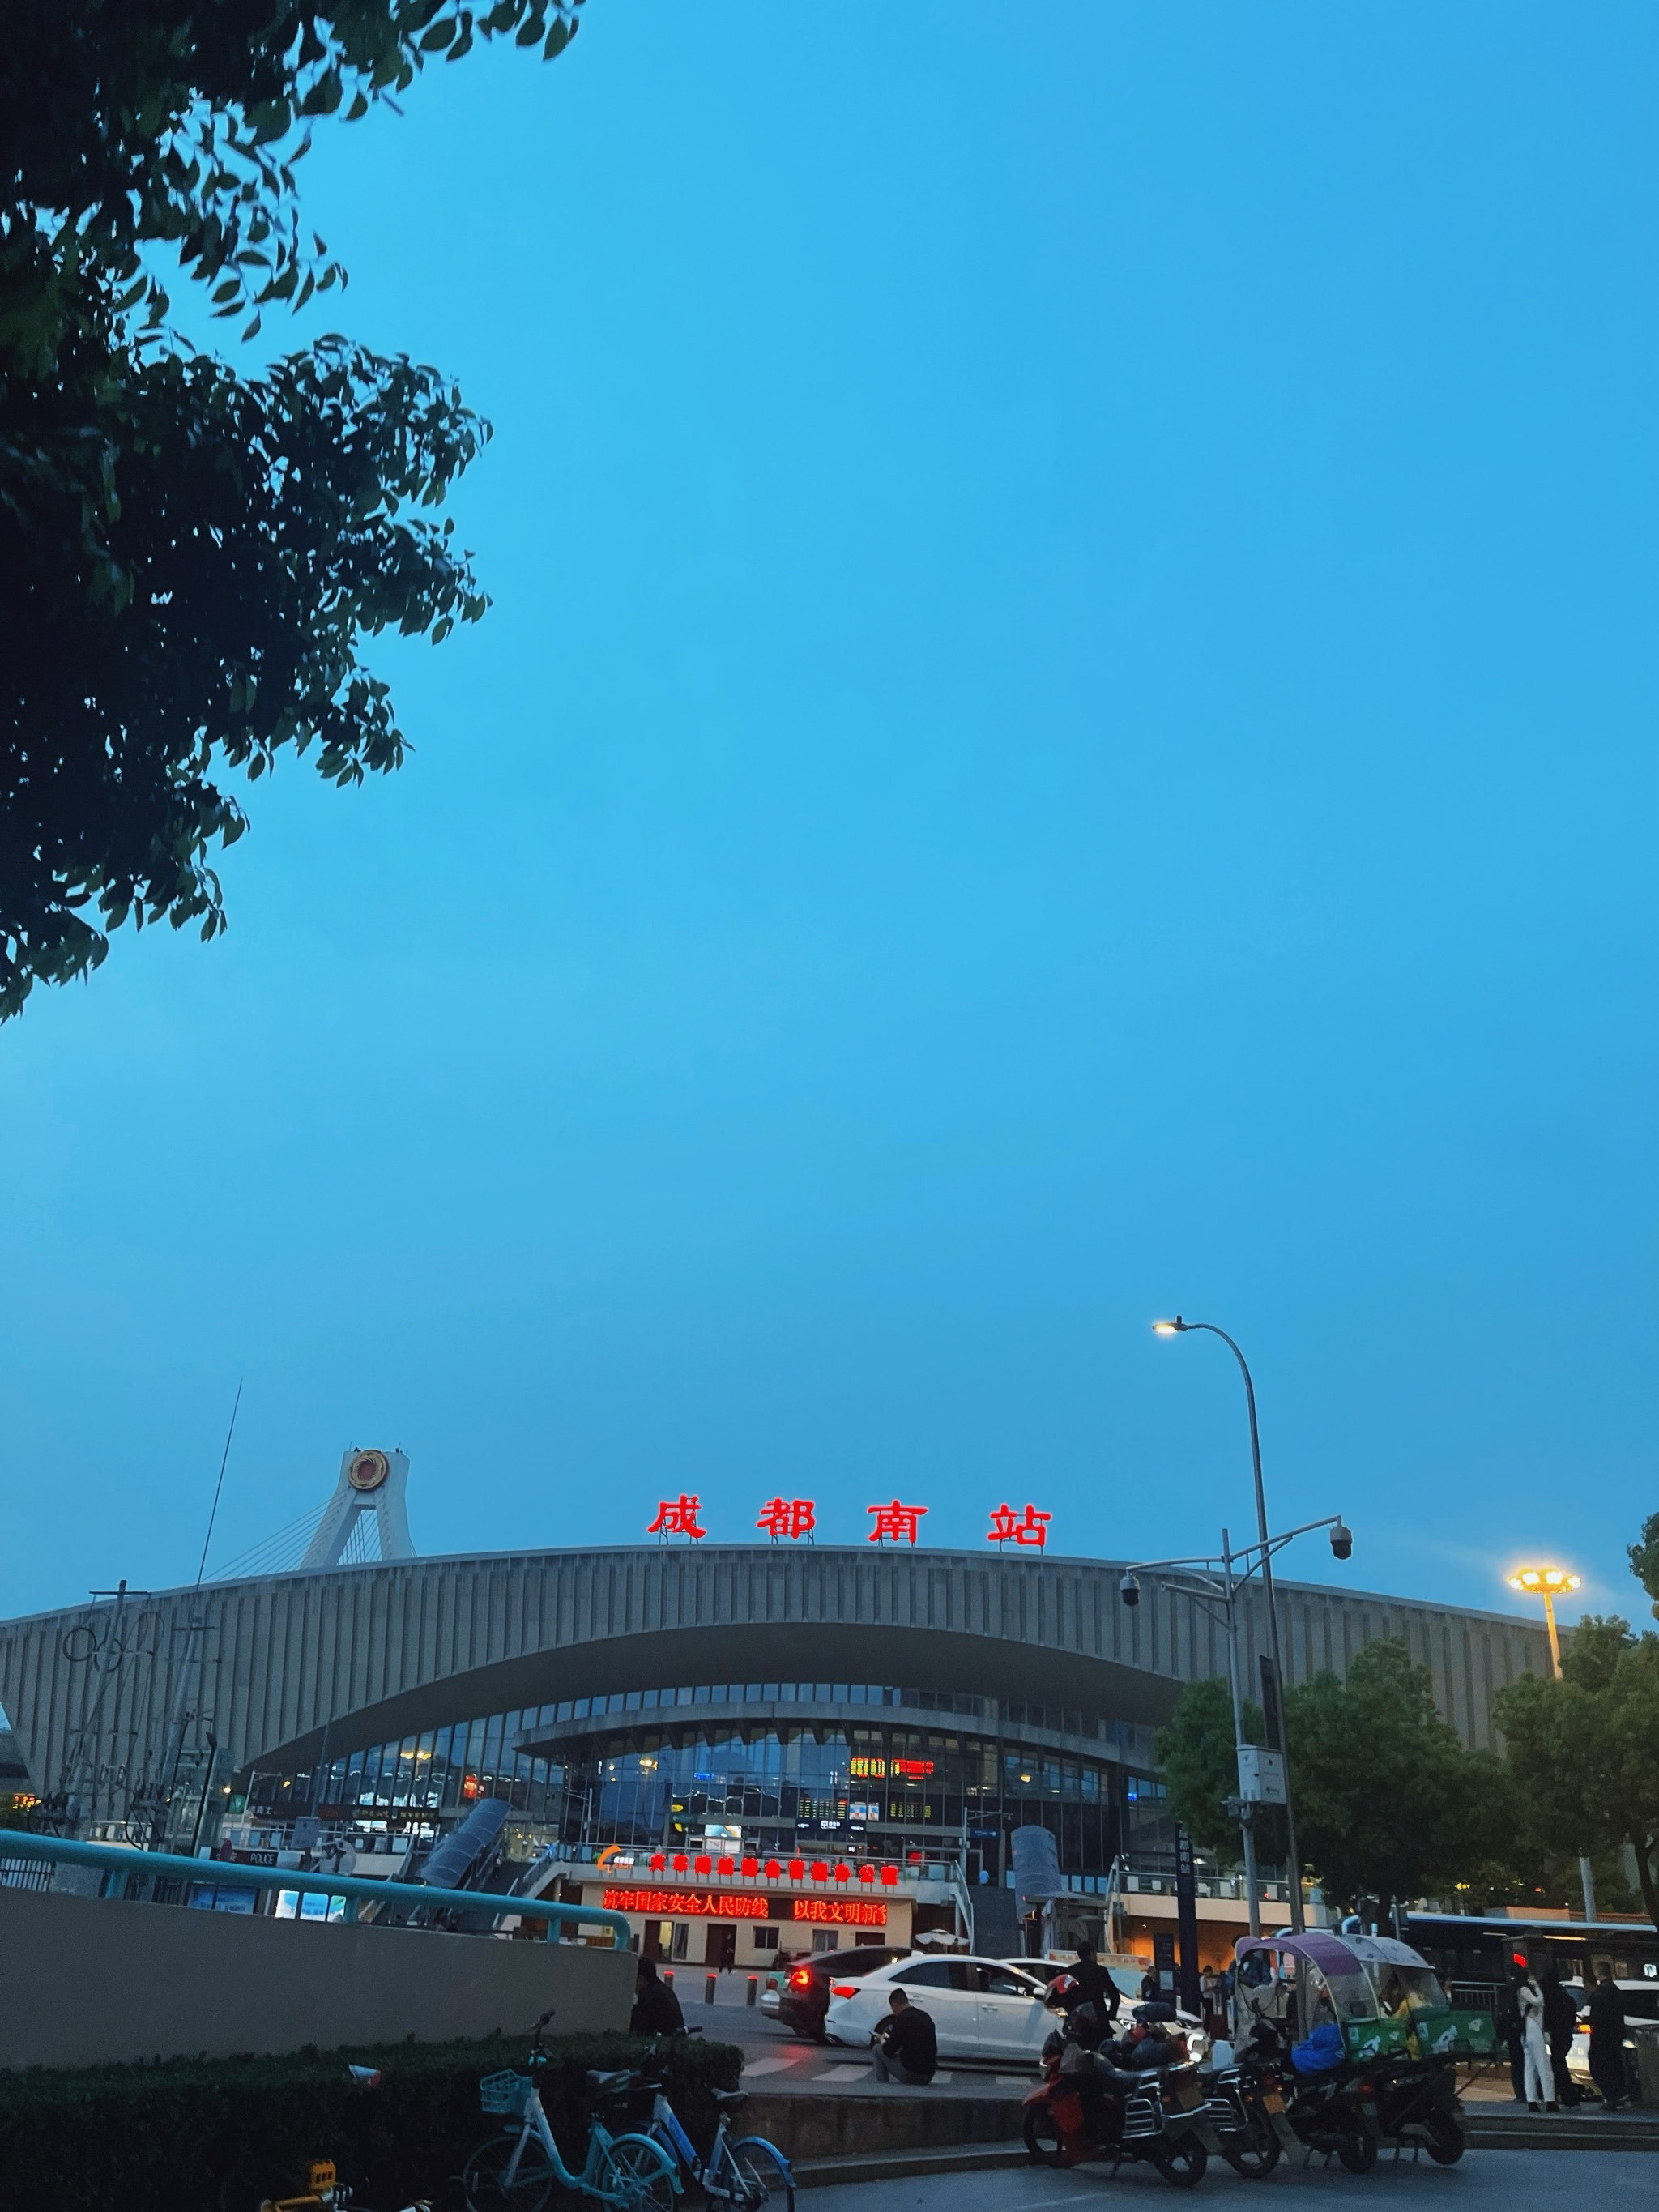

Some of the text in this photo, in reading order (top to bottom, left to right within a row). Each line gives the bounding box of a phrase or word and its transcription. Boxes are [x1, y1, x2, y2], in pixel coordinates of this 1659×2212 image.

[646, 1493, 1052, 1547] 成都南站
[250, 1852, 275, 1864] POLICE
